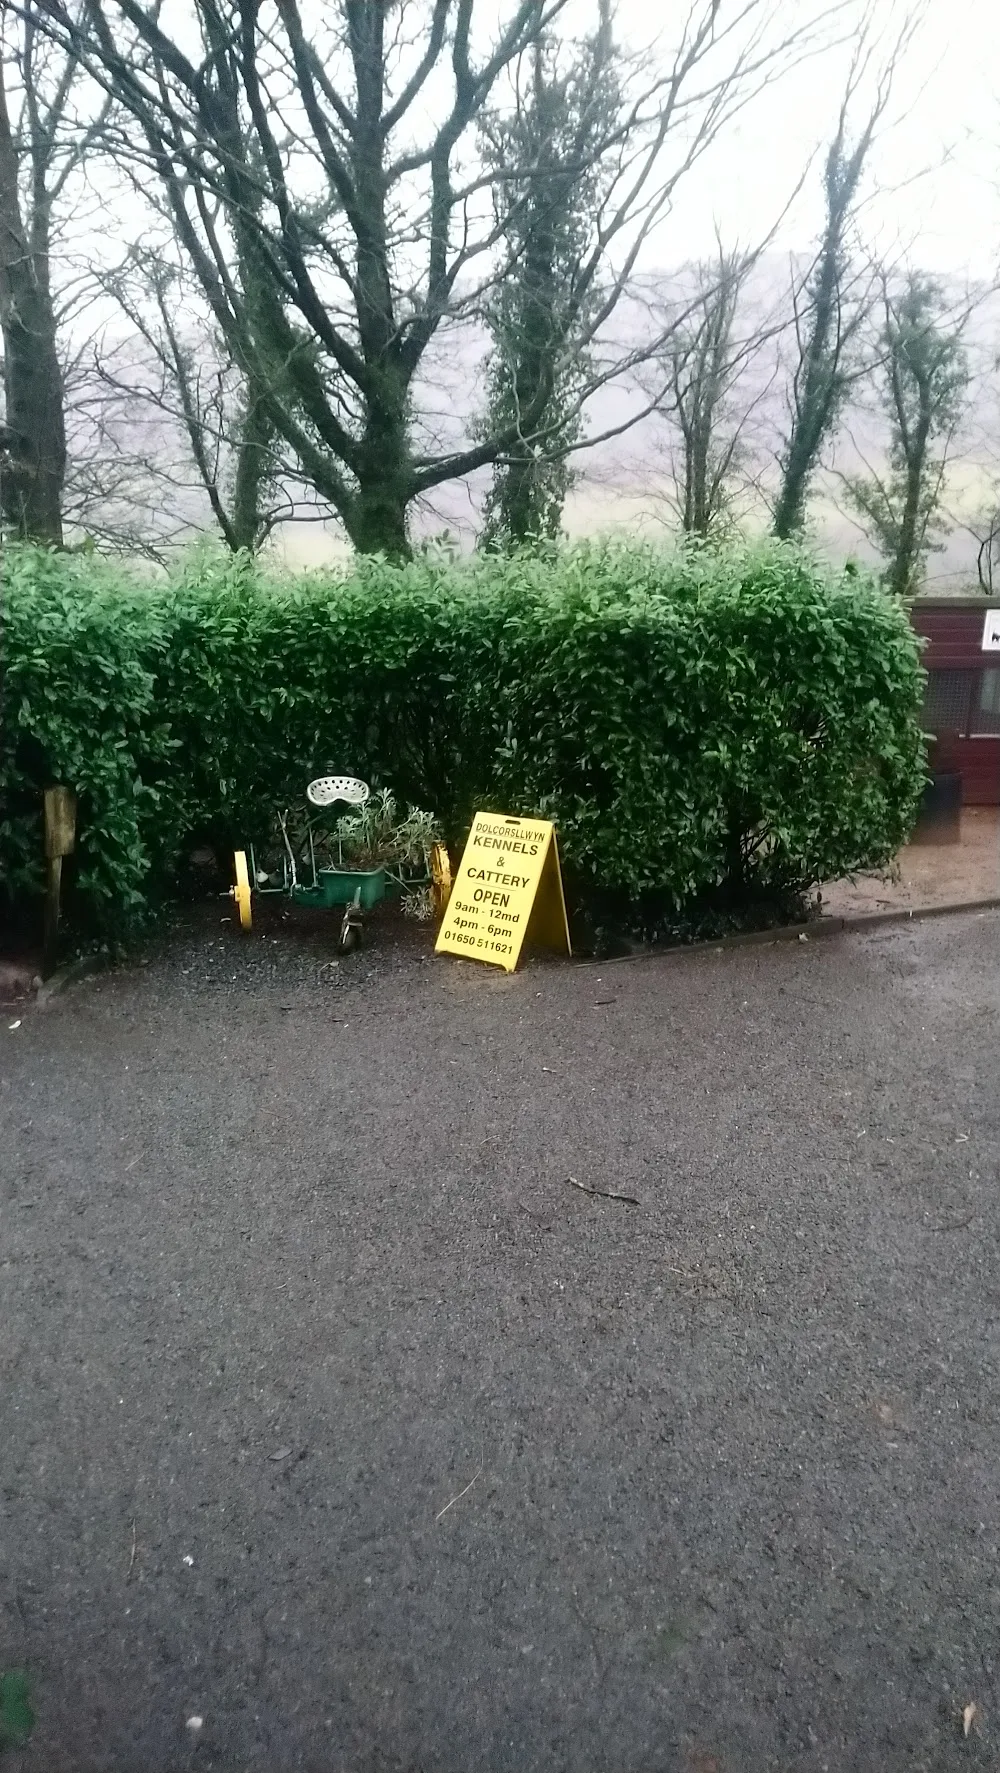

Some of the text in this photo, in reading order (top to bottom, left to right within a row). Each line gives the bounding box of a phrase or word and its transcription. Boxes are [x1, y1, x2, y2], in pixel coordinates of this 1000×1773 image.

[473, 835, 539, 856] KENNELS
[496, 856, 505, 867] &
[467, 867, 530, 888] CATTERY
[473, 888, 510, 907] OPEN
[454, 901, 479, 914] 9am
[489, 909, 520, 923] 12md
[453, 916, 478, 930] 4pm
[487, 924, 512, 938] 6pm
[444, 930, 513, 955] 01650 511621
